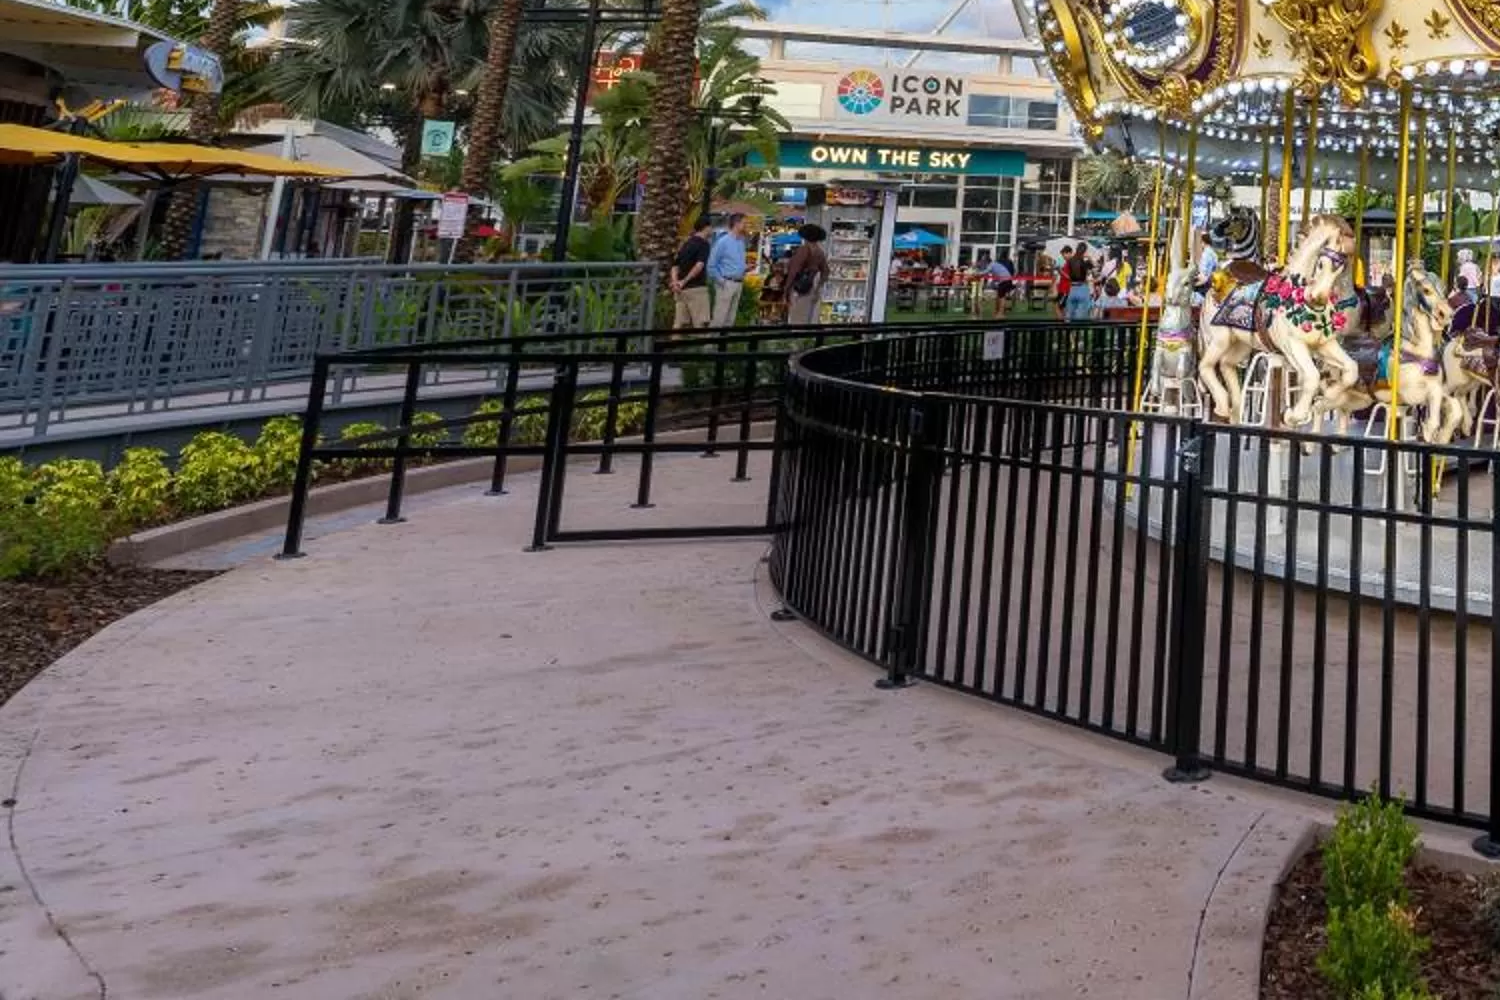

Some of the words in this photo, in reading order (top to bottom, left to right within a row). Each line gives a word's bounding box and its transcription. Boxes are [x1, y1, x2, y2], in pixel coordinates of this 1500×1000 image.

[891, 74, 963, 96] ICON
[889, 96, 961, 117] PARK
[811, 146, 868, 164] OWN
[878, 149, 920, 167] THE
[929, 151, 971, 168] SKY
